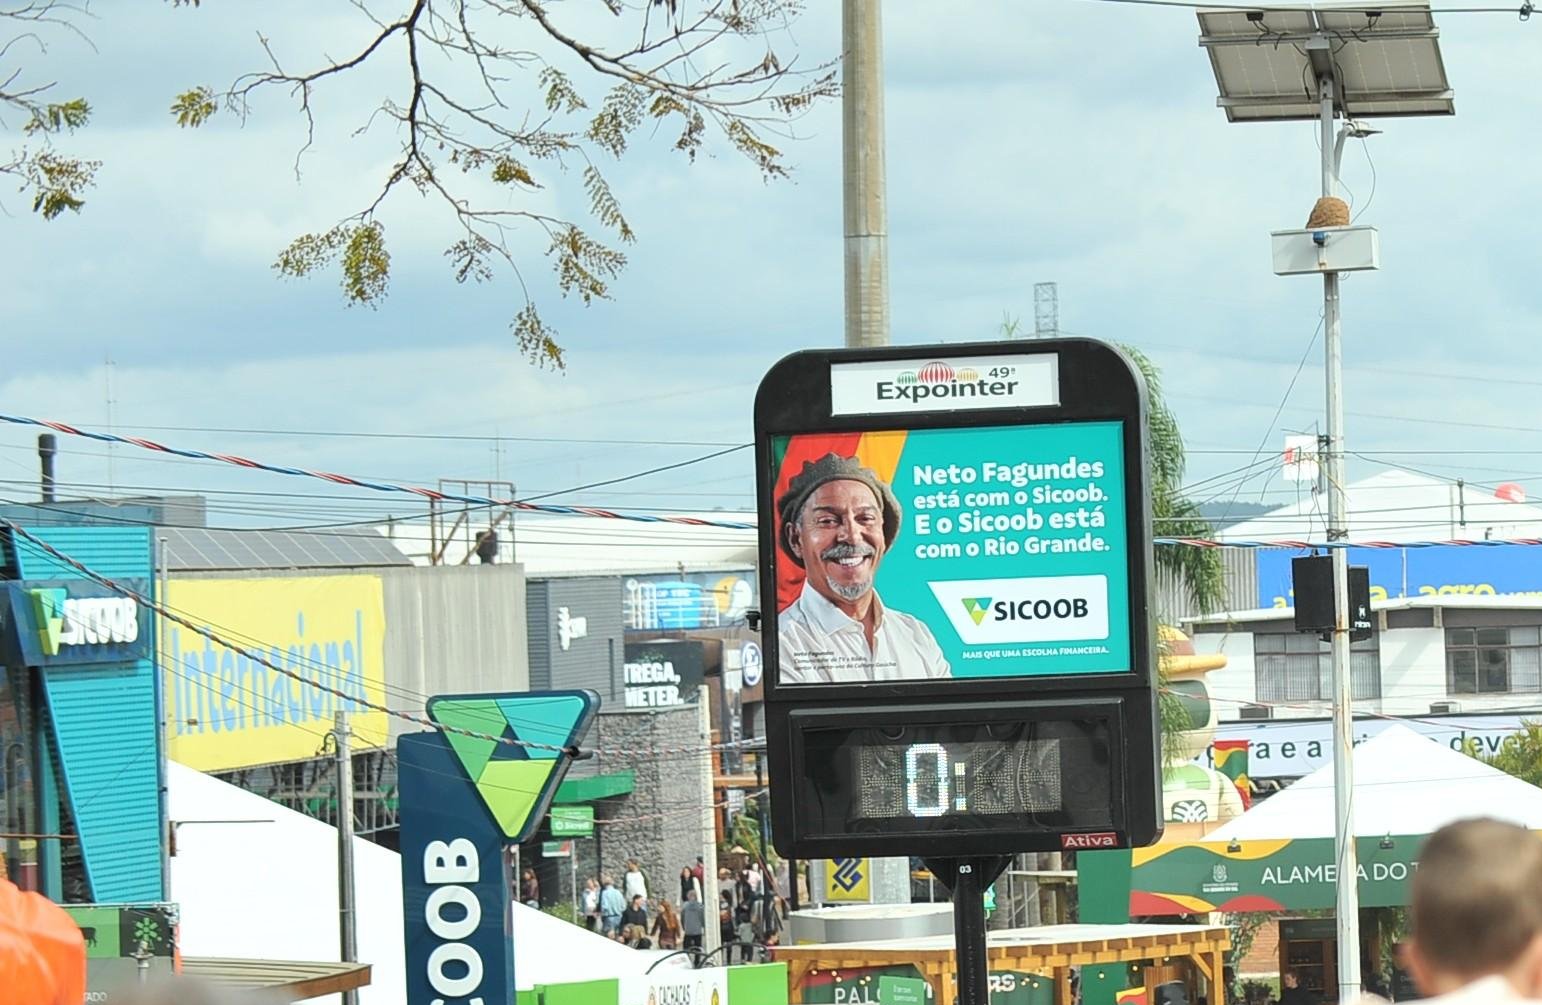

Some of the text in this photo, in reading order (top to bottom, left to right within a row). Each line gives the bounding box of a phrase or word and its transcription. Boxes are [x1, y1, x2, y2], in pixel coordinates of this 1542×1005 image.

[876, 379, 1019, 403] Expointer
[913, 456, 1104, 487] Neto Fagundes
[913, 482, 1109, 509] está com o Sicoob.
[914, 505, 1105, 535] E o Sicoob está
[914, 532, 1110, 558] com o Rio Grande.
[994, 598, 1089, 621] SICOOB
[962, 646, 1110, 660] MAIS QUE UMA ESCOLHA FINANCEIRA.
[172, 608, 367, 736] Internacional
[1307, 740, 1322, 758] a
[1064, 833, 1114, 848] Ativa
[959, 864, 972, 874] 03
[1261, 863, 1369, 885] ALAMEA
[1373, 862, 1407, 881] DO
